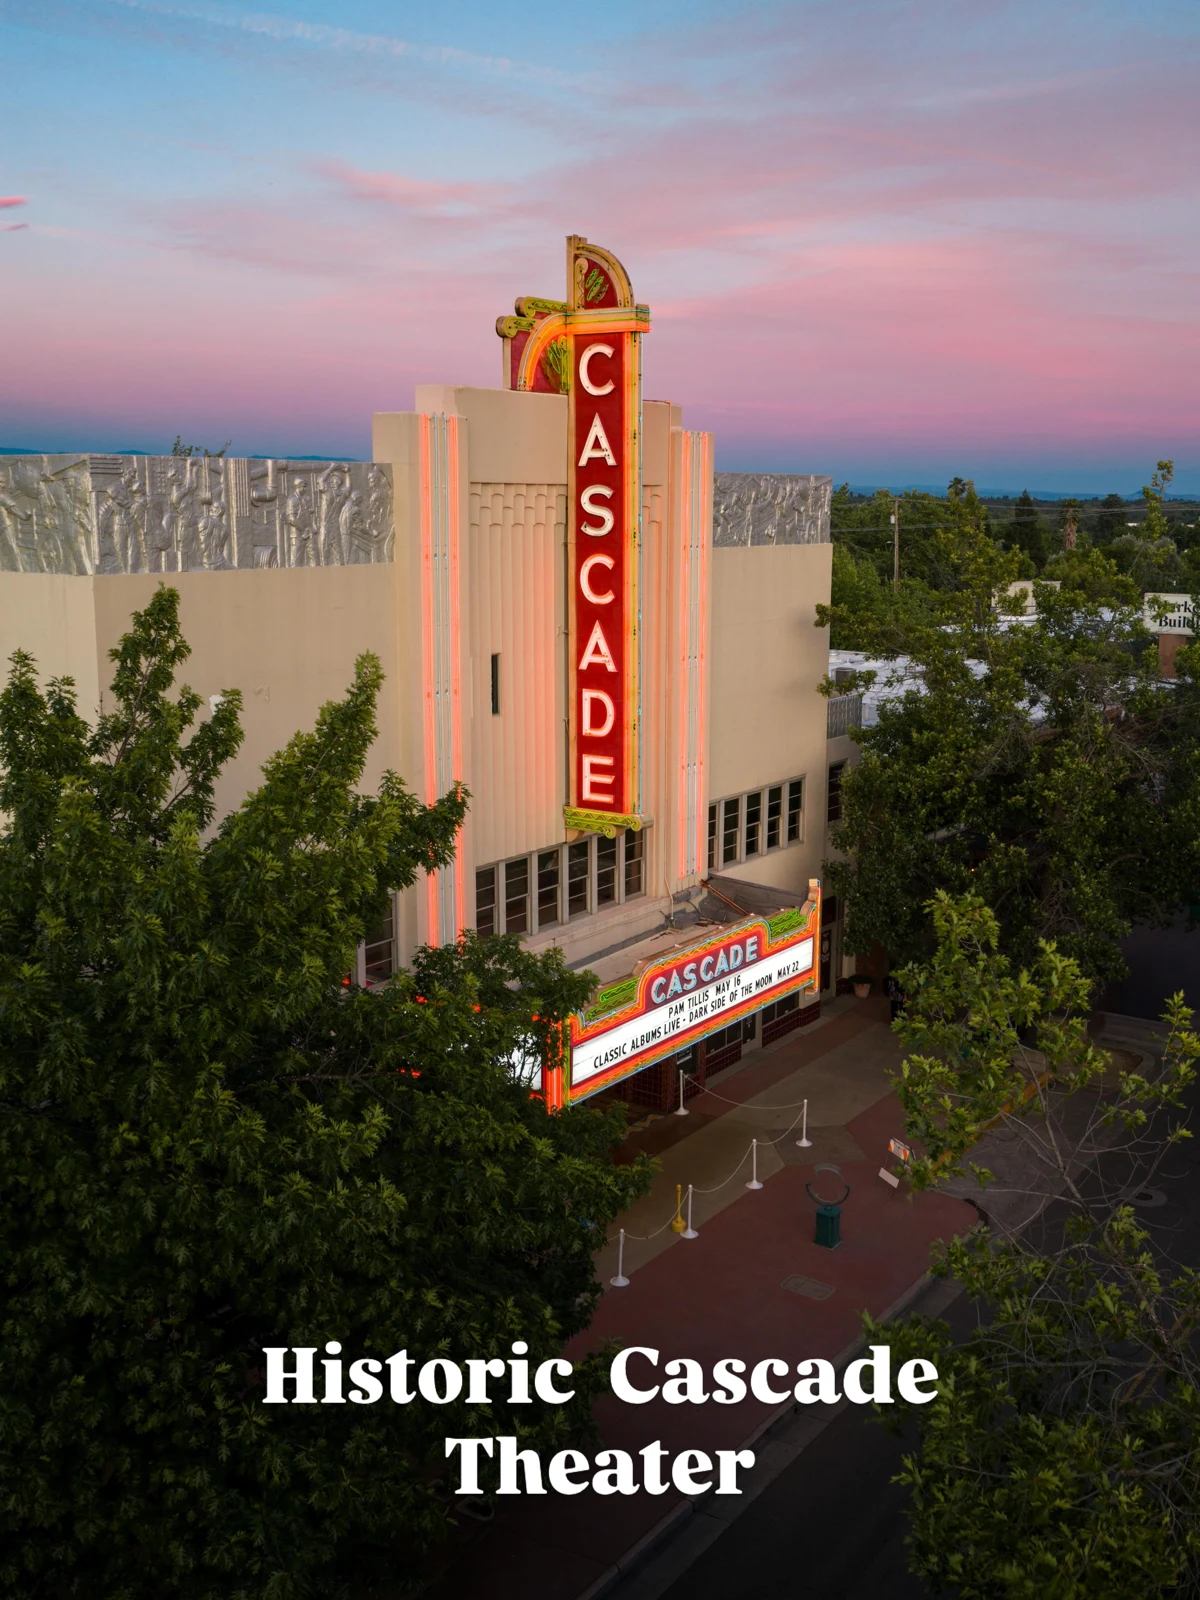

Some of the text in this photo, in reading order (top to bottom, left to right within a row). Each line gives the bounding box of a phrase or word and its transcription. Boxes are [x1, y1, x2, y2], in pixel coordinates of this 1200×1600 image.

[578, 342, 618, 805] CASCADE
[651, 935, 759, 1004] CASCADE
[668, 974, 742, 1018] PAM TILLIS MAY 16
[593, 1043, 627, 1069] CLASSIC
[630, 1024, 662, 1051] ALBUMS
[663, 1018, 681, 1038] LIVE
[689, 1005, 709, 1023] DARK
[710, 996, 726, 1014] SIDE
[730, 987, 740, 1002] OF
[741, 983, 753, 998] THE
[755, 973, 773, 992] MOON
[777, 966, 791, 983] MAY
[791, 960, 800, 974] 22
